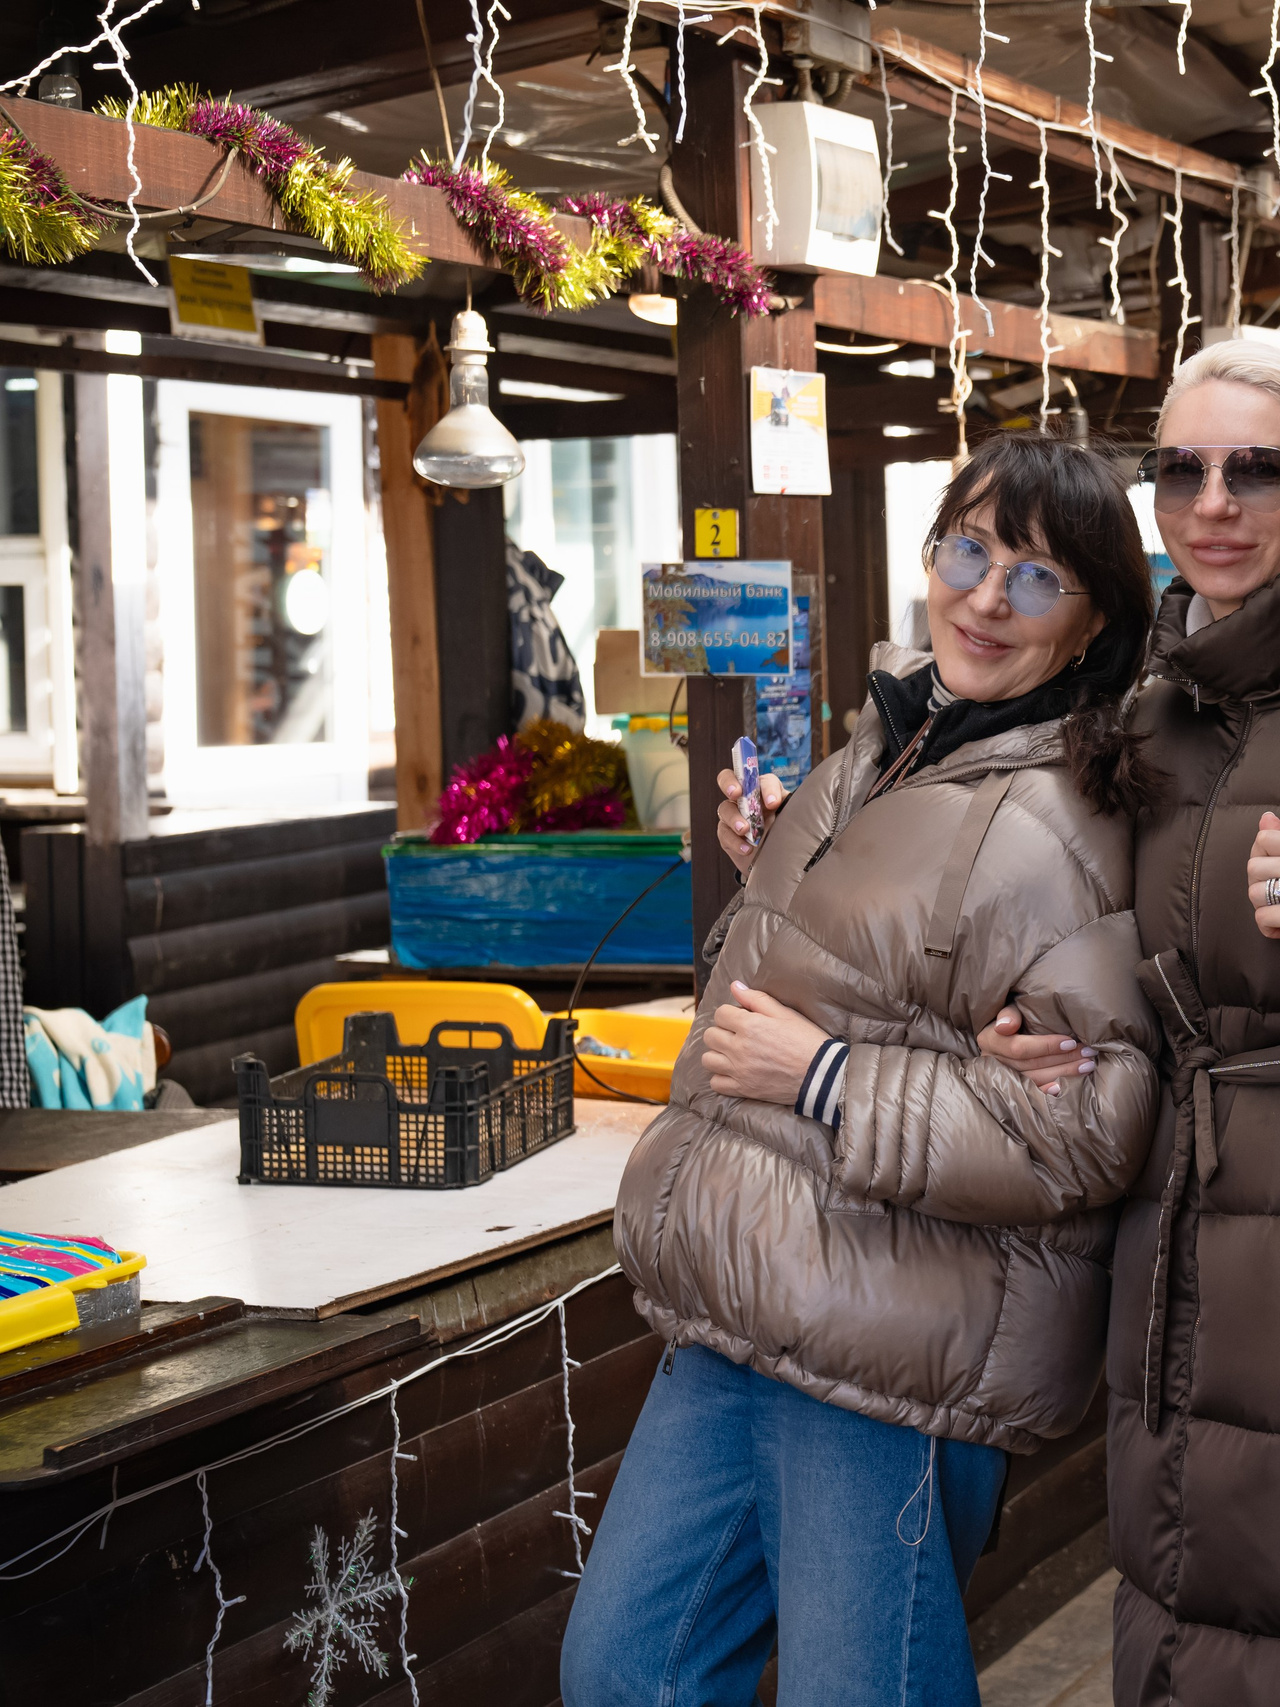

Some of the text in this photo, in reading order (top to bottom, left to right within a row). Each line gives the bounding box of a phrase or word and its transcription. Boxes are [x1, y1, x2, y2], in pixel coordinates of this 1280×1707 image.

[710, 523, 721, 546] 2
[649, 583, 783, 598] Мобильный банк
[650, 630, 787, 648] 8-908-655-04-82
